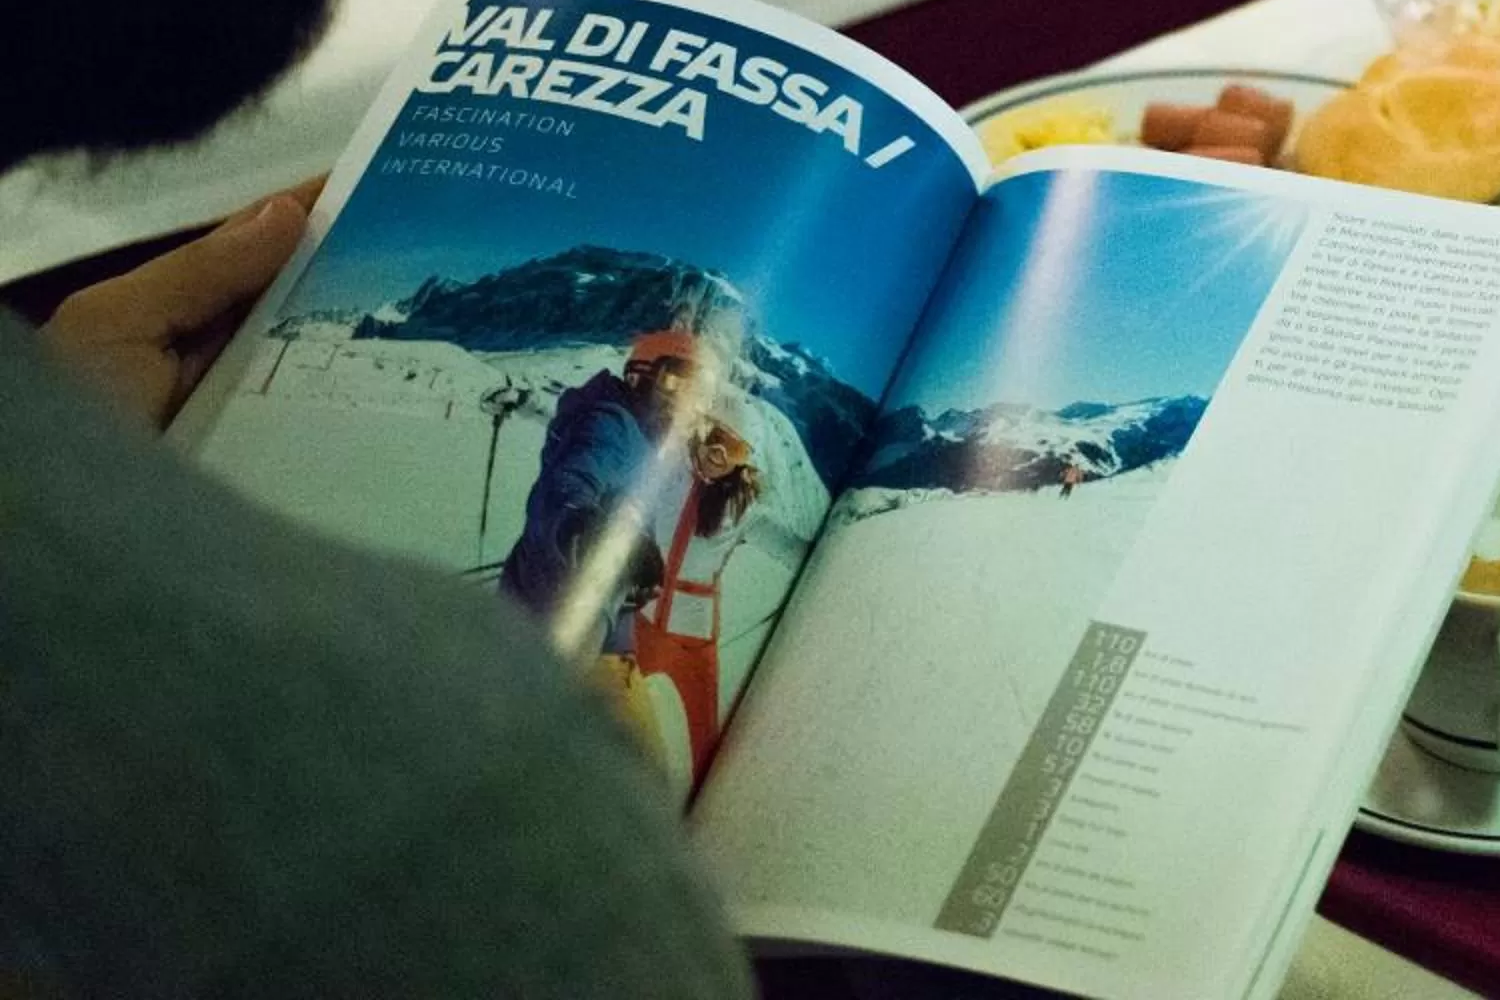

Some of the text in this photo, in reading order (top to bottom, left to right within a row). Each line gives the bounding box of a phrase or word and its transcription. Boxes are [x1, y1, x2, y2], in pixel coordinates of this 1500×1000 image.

[416, 51, 708, 141] CAREZZA
[446, 5, 556, 51] VAL
[564, 13, 648, 63] DI
[649, 29, 863, 156] FASSA
[398, 130, 505, 153] VARIOUS
[412, 104, 575, 137] FASCINATION
[377, 156, 578, 199] INTERNATIONAL
